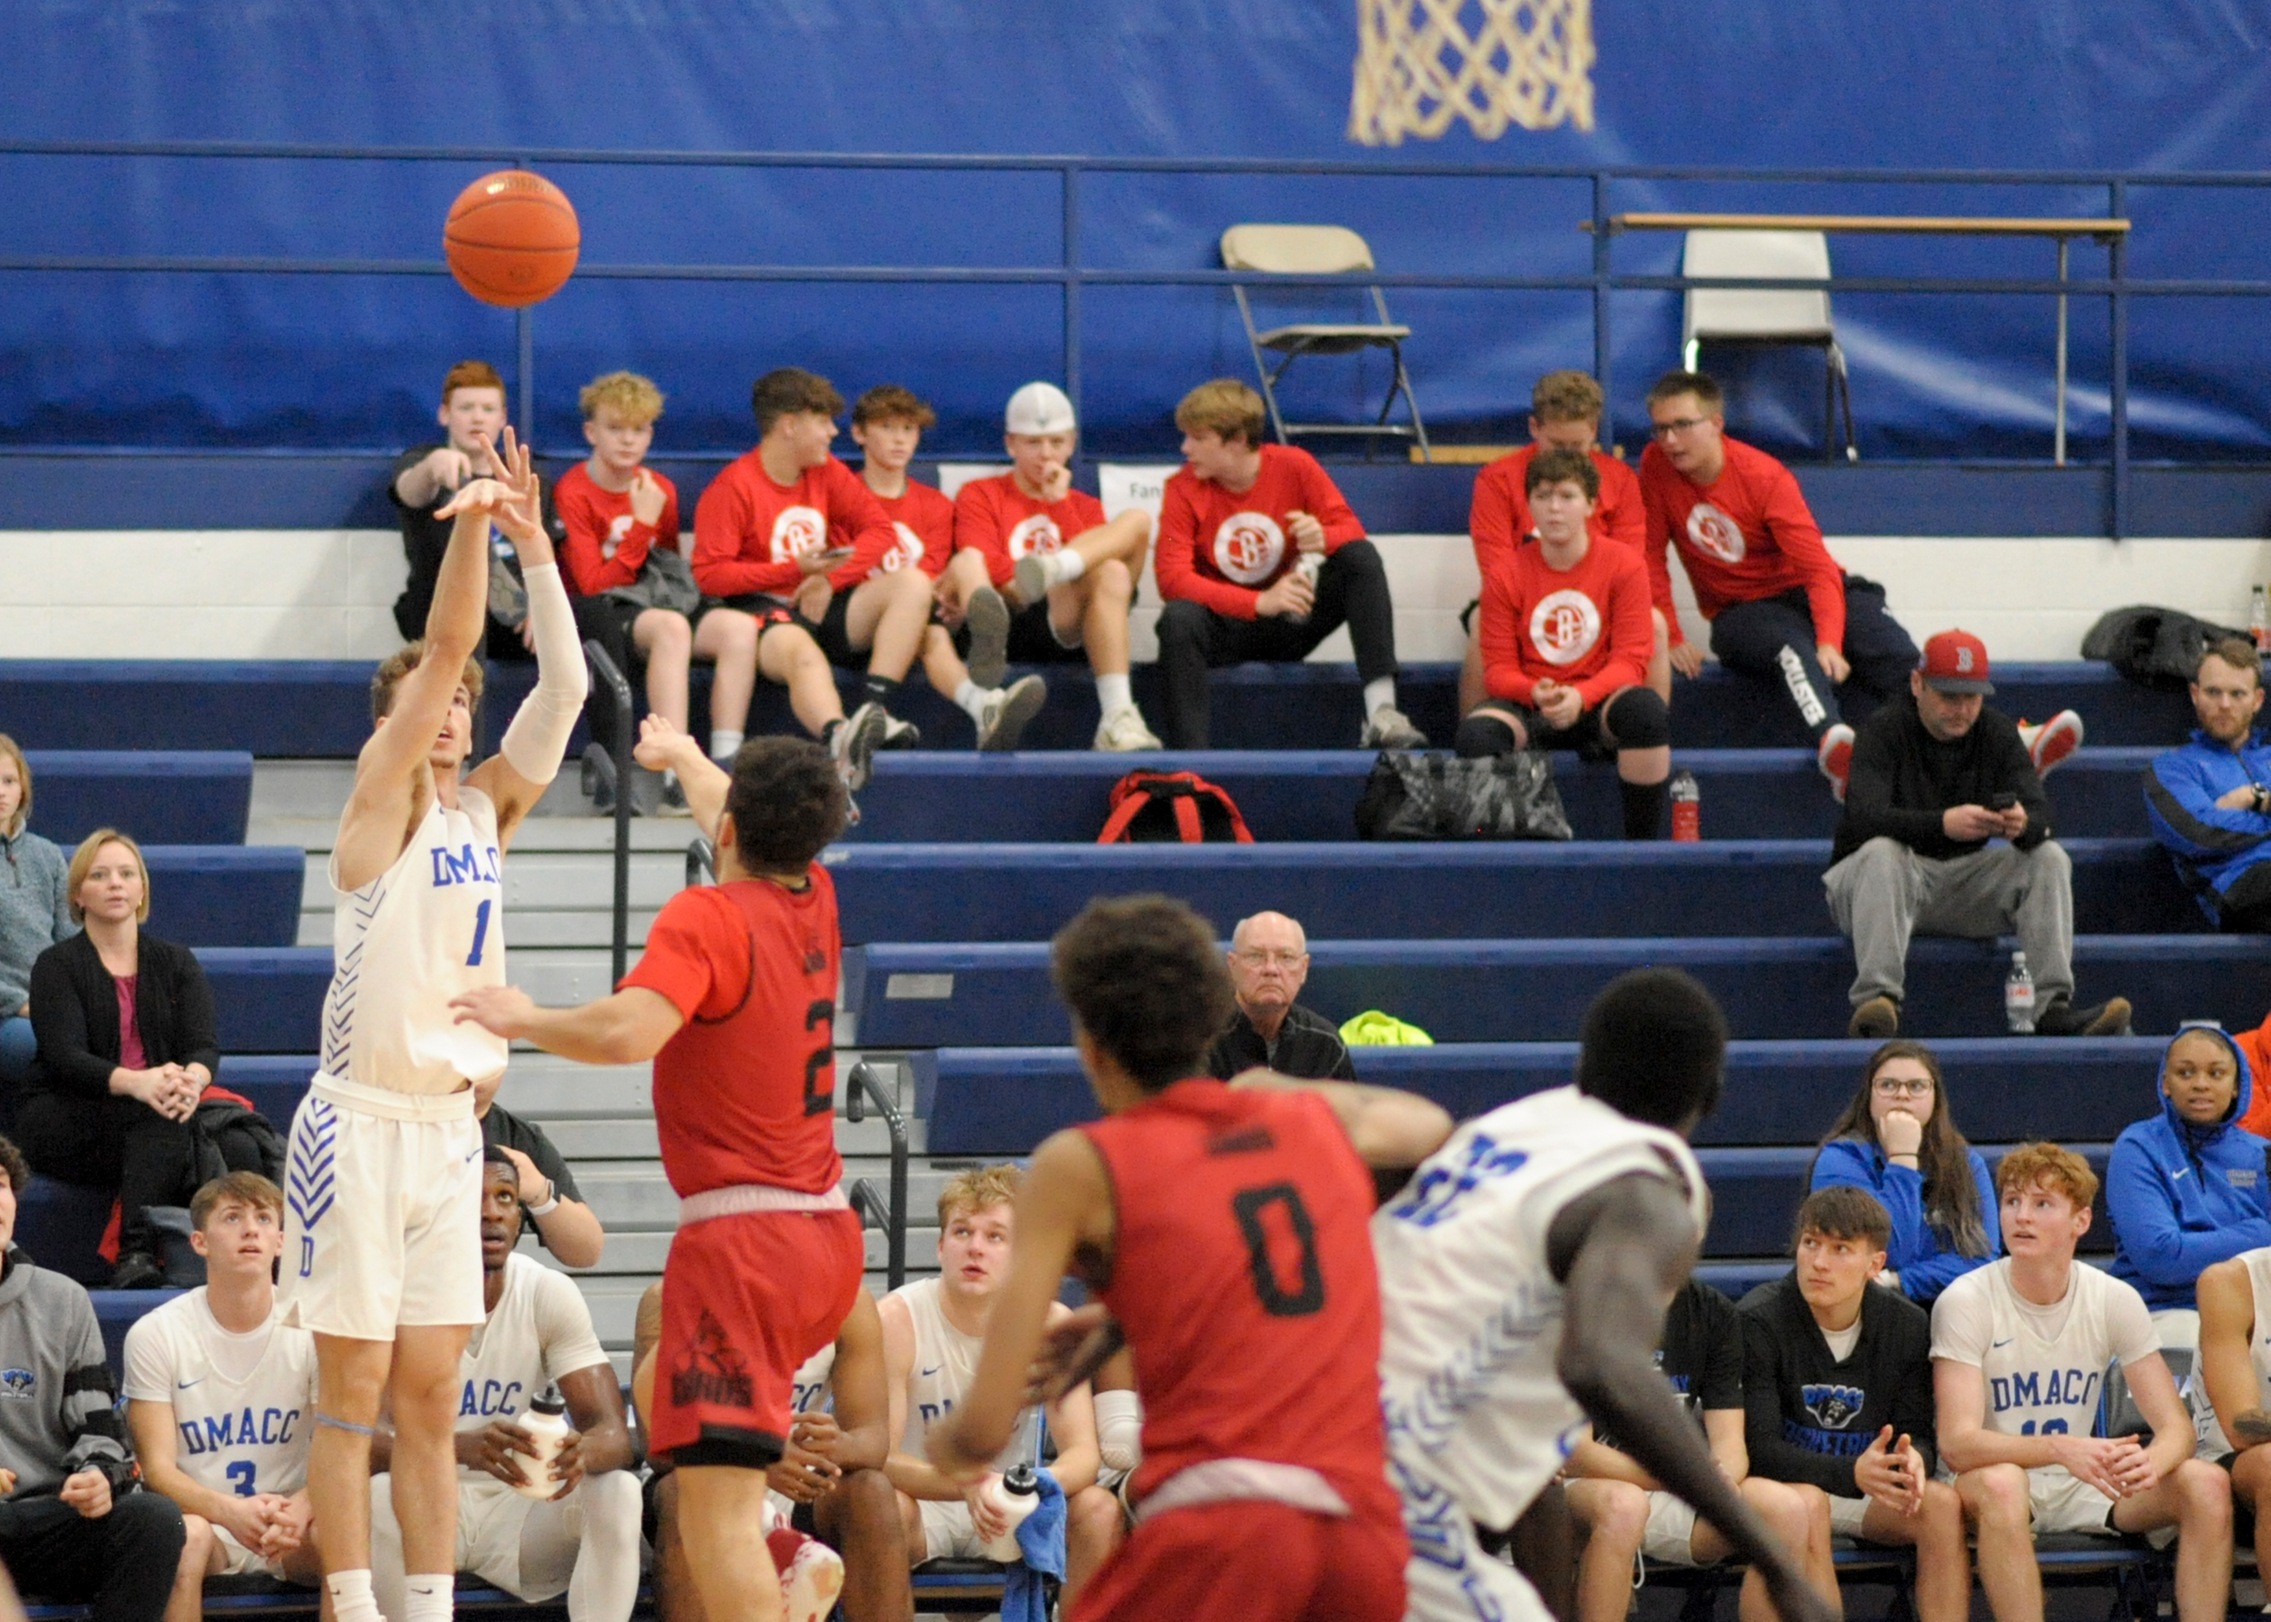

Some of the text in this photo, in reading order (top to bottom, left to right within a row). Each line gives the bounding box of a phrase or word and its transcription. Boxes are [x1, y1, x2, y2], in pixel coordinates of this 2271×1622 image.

[1955, 646, 1974, 673] B
[465, 899, 492, 966] 1
[804, 999, 835, 1117] 2
[1233, 1181, 1325, 1317] 0
[179, 1406, 300, 1455] DMACC
[226, 1459, 257, 1498] 3
